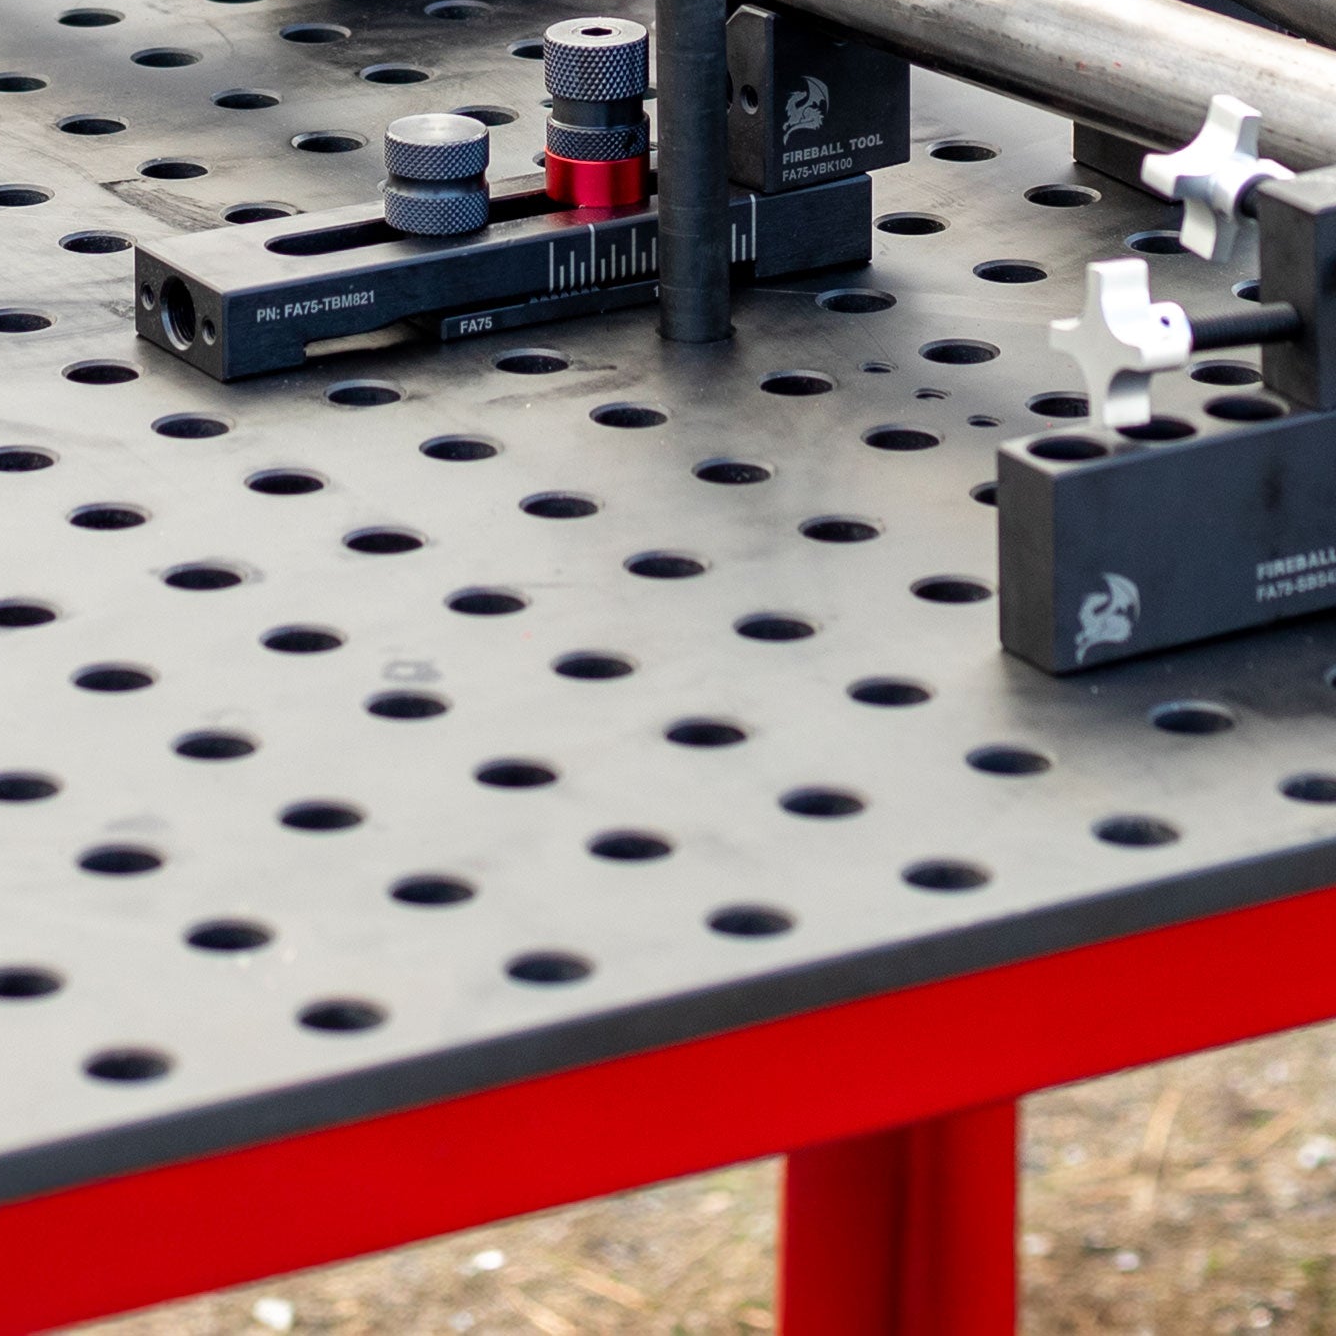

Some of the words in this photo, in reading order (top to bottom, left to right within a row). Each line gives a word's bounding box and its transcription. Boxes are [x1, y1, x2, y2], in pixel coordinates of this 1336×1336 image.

[782, 142, 844, 165] FIREBALL
[849, 133, 884, 151] TOOL
[782, 157, 853, 182] FA75-VBK100
[256, 306, 281, 323] PN:
[284, 290, 375, 318] FA75-TBM821
[459, 316, 493, 334] FA75
